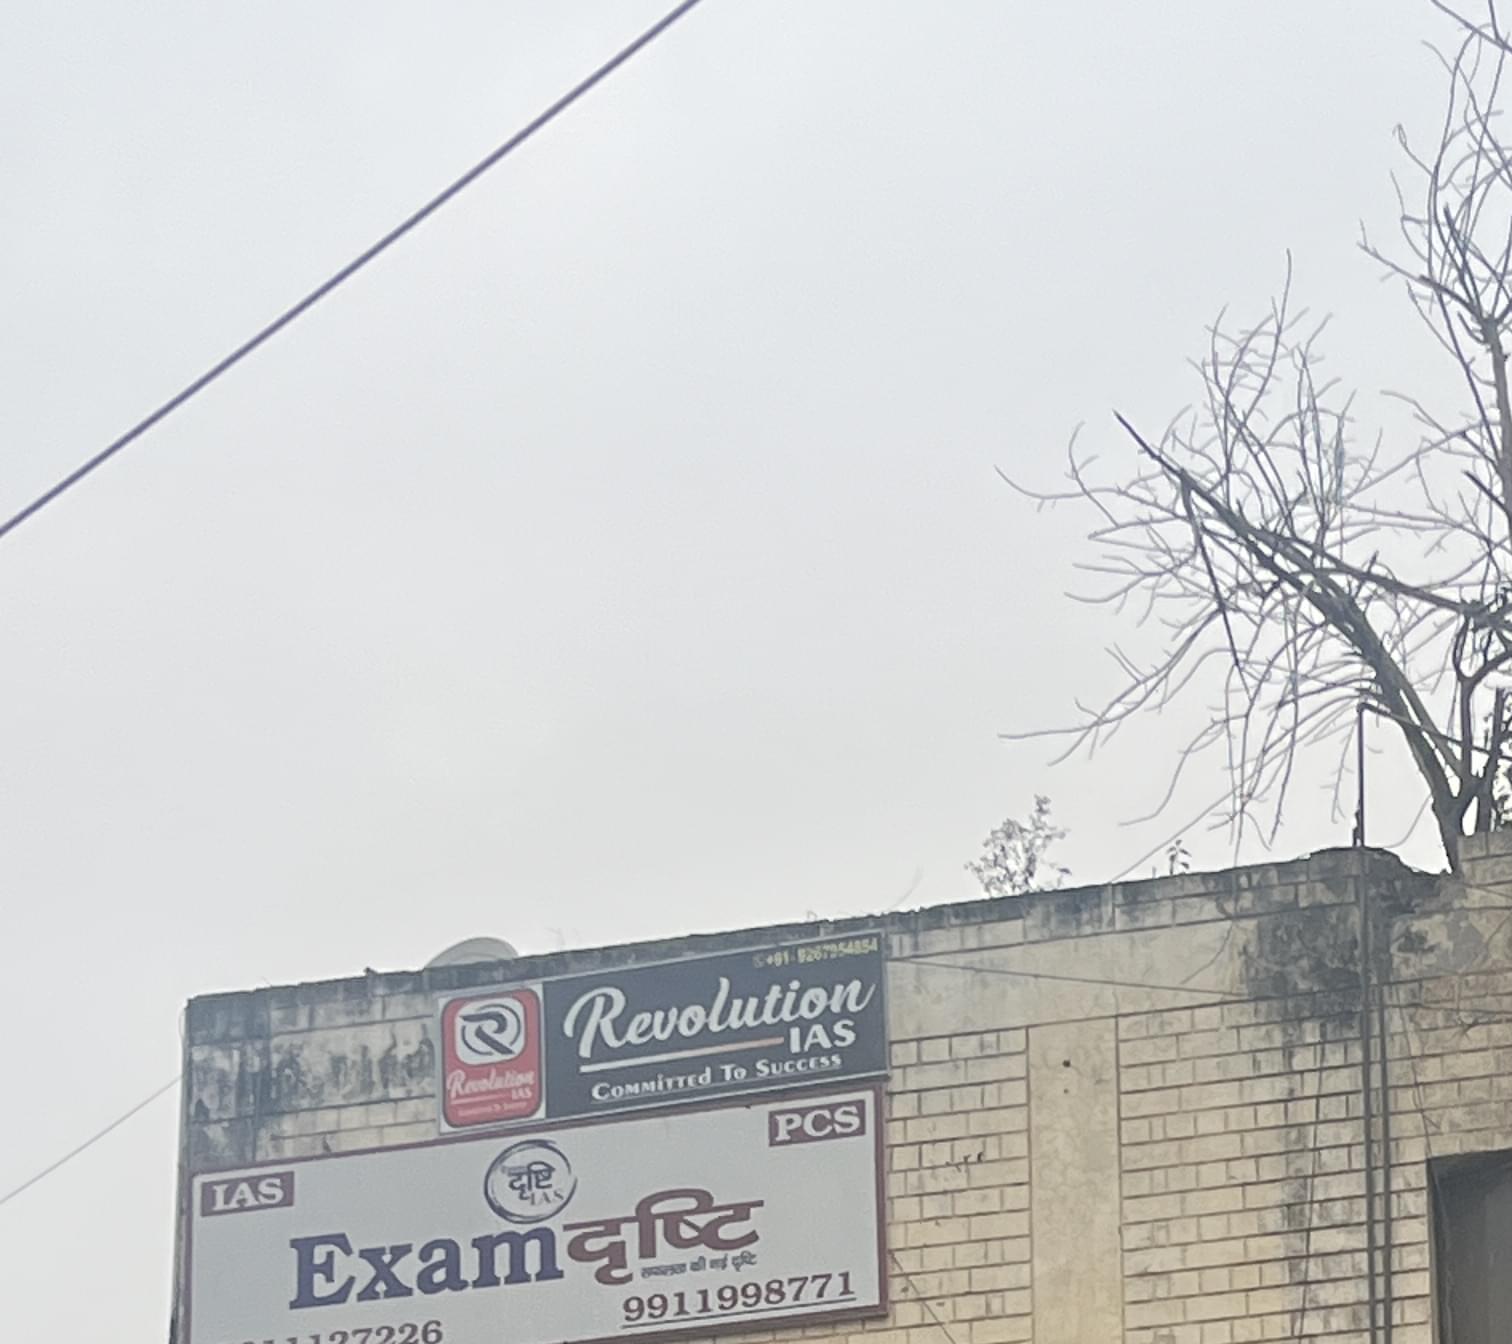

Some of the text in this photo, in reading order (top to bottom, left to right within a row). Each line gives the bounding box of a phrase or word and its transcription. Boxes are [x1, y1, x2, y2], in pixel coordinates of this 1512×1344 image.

[563, 976, 876, 1059] Revolution
[788, 1019, 856, 1053] IAS
[447, 1069, 535, 1098] Revolution
[774, 1107, 861, 1141] PCS
[211, 1178, 285, 1211] IAS
[621, 1271, 855, 1322] 9911998771
